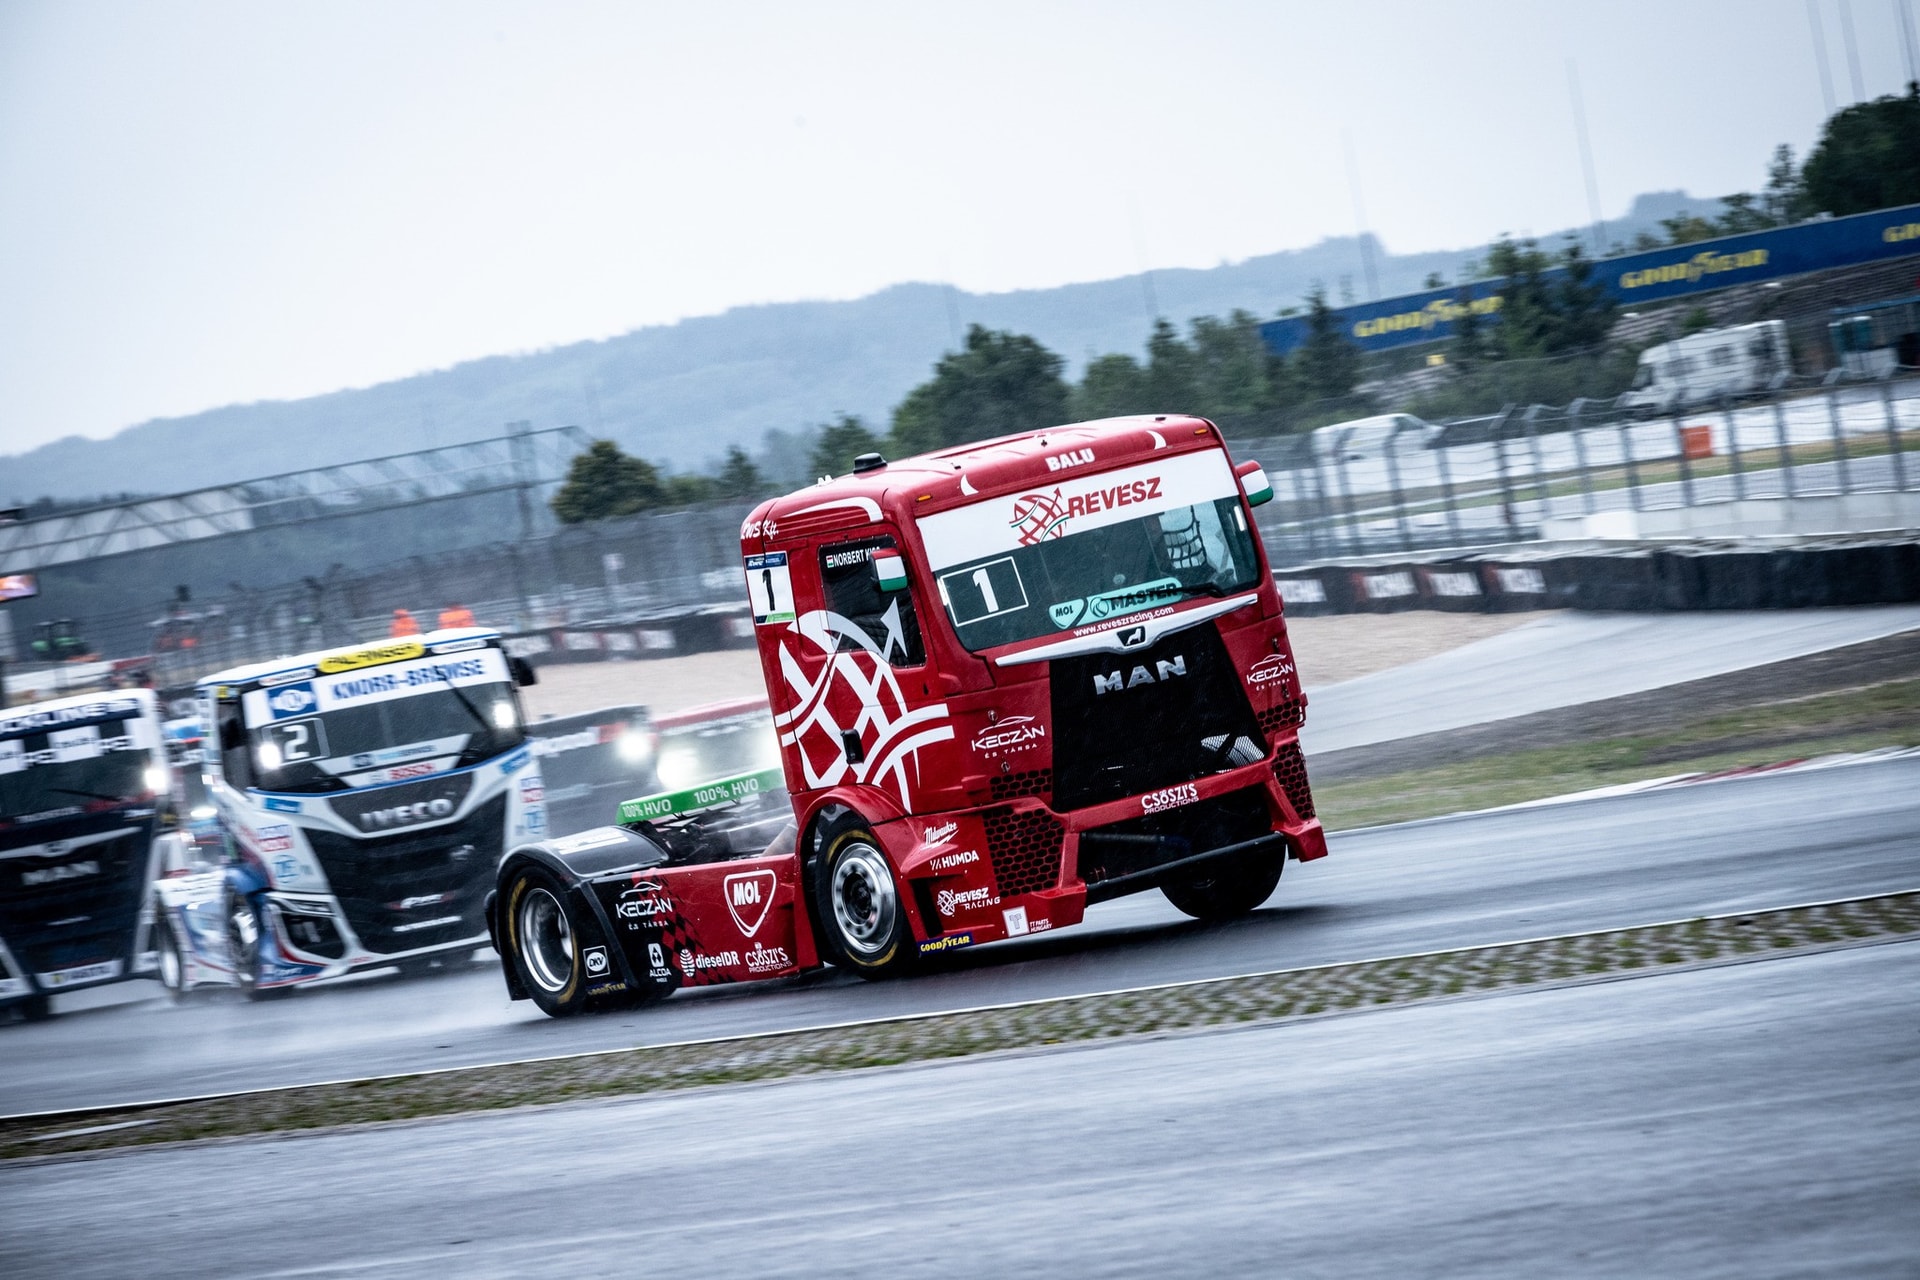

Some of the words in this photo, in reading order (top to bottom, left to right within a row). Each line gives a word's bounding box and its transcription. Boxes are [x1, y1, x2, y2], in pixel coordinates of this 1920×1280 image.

[1045, 448, 1096, 472] BALU
[1068, 477, 1163, 518] REVESZ
[833, 549, 865, 567] NORBERT
[762, 569, 776, 611] 1
[972, 568, 999, 613] 1
[1111, 582, 1178, 611] MASTER
[1055, 605, 1074, 618] MOL
[1073, 606, 1175, 637] www.reveszracing.com
[1093, 655, 1187, 695] MAN
[282, 724, 310, 761] 2
[694, 785, 729, 805] 100%
[731, 778, 760, 796] HVO
[359, 798, 453, 826] IVECO
[622, 803, 644, 818] 100%
[644, 799, 672, 815] HVO
[1144, 796, 1199, 815] PRODUCTIONS
[942, 850, 980, 869] HUMDA
[733, 881, 761, 906] MOL
[954, 887, 989, 904] REVESZ
[965, 896, 1000, 911] RACING
[920, 935, 970, 952] GOODYEAR
[695, 951, 741, 969] dieselDR
[649, 968, 672, 977] ALCOA
